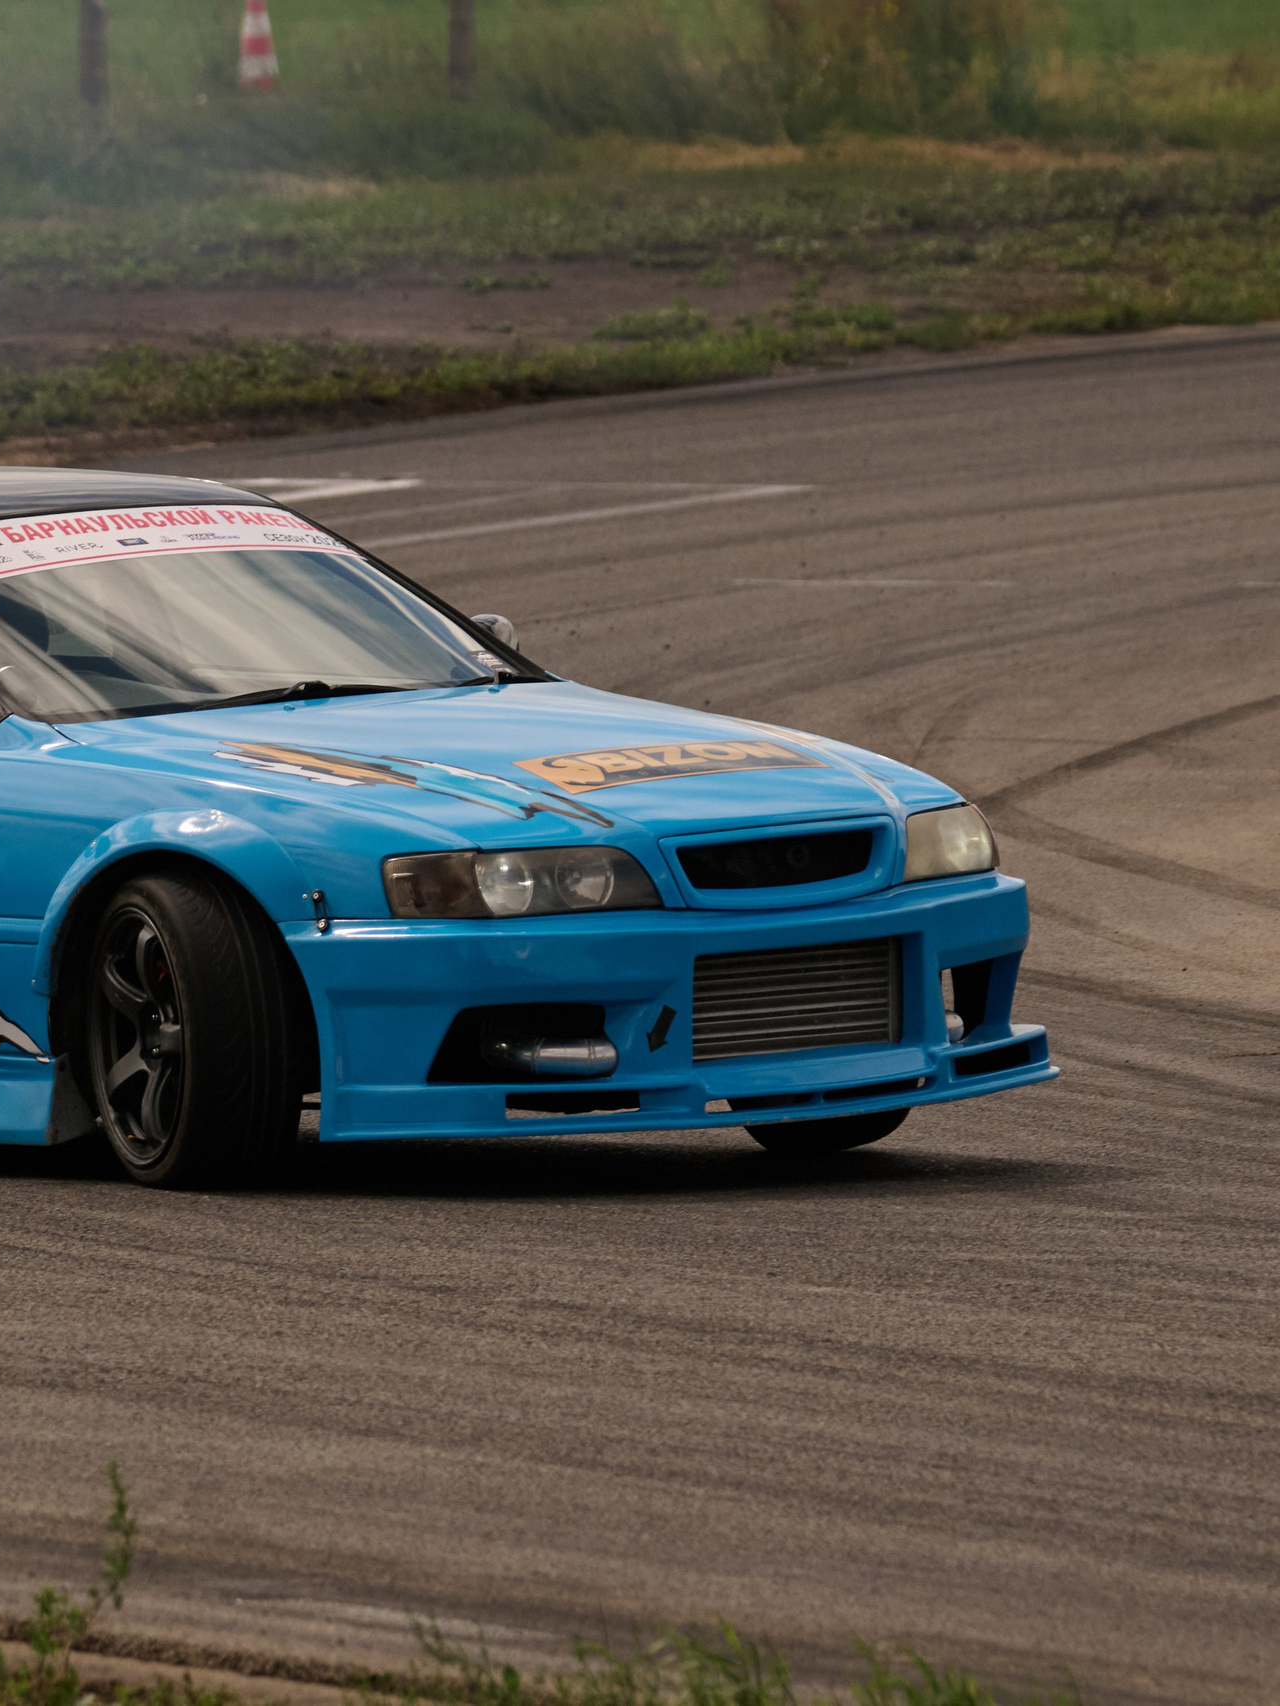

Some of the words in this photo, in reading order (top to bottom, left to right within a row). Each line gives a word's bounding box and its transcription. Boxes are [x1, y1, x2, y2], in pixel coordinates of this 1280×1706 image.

[0, 507, 216, 544] БАРНАУЛЬСКОЙ
[54, 542, 104, 554] RIVER
[263, 533, 308, 543] СЕЗОН
[593, 742, 797, 773] BIZON
